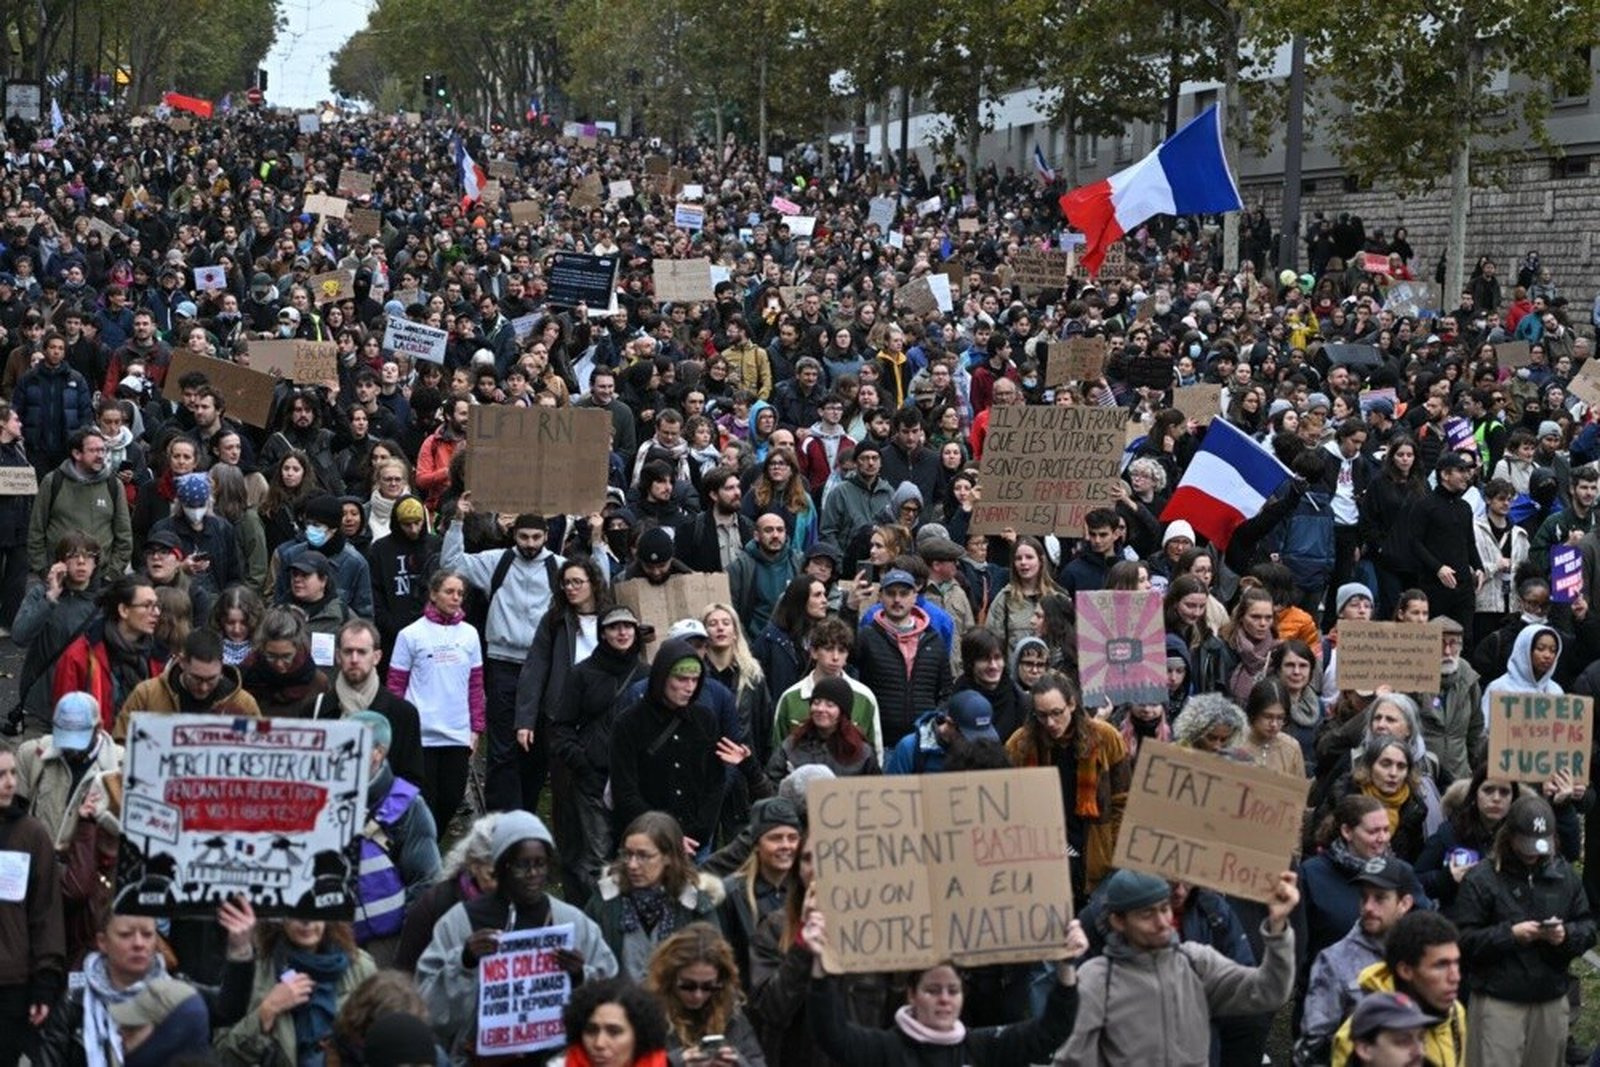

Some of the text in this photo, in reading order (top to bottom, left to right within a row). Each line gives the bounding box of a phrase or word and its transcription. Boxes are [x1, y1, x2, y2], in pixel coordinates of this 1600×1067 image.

[536, 409, 575, 445] RN
[988, 431, 1018, 453] QUE
[1022, 431, 1047, 454] LES
[996, 481, 1024, 500] LES
[1086, 482, 1109, 501] LES
[1500, 696, 1586, 720] TIRER
[1553, 720, 1584, 743] PAS
[158, 752, 349, 782] MERCI DE RESTER CALME
[1499, 749, 1585, 777] JUGER
[819, 781, 1010, 830] C'EST EN
[815, 825, 1064, 878] PRENANT BASTILLE
[945, 875, 965, 900] A
[989, 870, 1034, 896] EU
[839, 902, 1070, 956] NOTRE NATION
[484, 958, 508, 983] NOS
[484, 982, 510, 1001] POUR
[512, 980, 526, 997] NE
